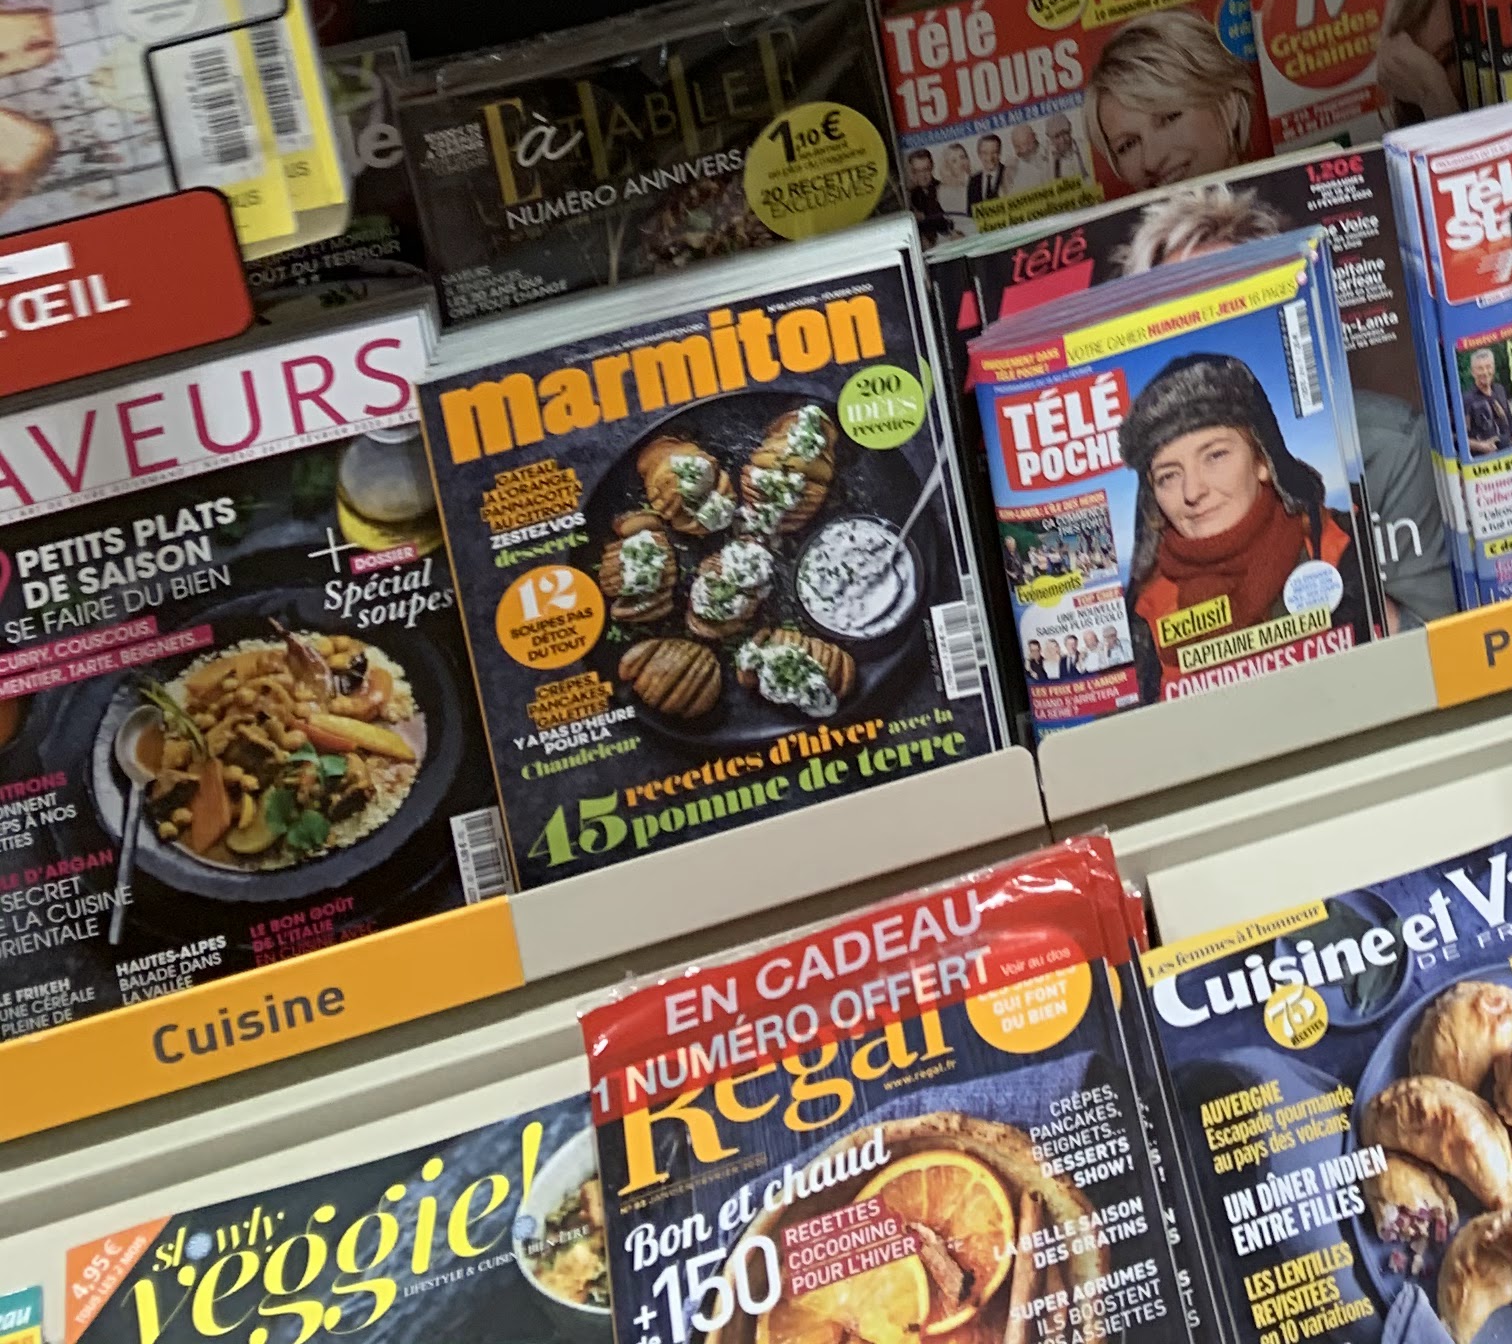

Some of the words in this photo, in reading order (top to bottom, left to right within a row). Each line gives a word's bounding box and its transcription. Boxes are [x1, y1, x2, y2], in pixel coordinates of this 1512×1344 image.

[1269, 8, 1382, 60] Grandes
[957, 38, 1085, 116] JOURS
[506, 184, 618, 230] NUMÉRO
[788, 161, 878, 198] RECETTES
[440, 295, 888, 465] marmiton
[855, 373, 903, 398] 200
[1002, 371, 1124, 451] TÉLÉ
[16, 527, 124, 580] PETITS
[132, 496, 238, 546] PLATS
[79, 535, 214, 595] SAISON
[494, 530, 591, 570] desserts
[323, 564, 433, 616] Spécial
[357, 584, 459, 631] soupes
[1160, 598, 1231, 646] Exclusif
[1182, 631, 1257, 670] CAPITAINE
[1258, 608, 1331, 650] MARLEAU
[623, 739, 766, 809] recettes
[769, 717, 886, 770] d'hiver
[526, 790, 635, 870] 45
[633, 771, 791, 852] pomme
[856, 727, 967, 780] terre
[115, 935, 227, 978] HAUTES-ALPES
[665, 976, 739, 1036] EN
[755, 889, 984, 1001] CADEAU
[1152, 924, 1399, 1028] Cuisine
[1401, 892, 1460, 952] et
[152, 986, 348, 1066] Cuisine
[624, 1005, 820, 1103] NUMÉRO
[829, 945, 992, 1030] OFFERT
[624, 1211, 714, 1270] Bon
[718, 1192, 760, 1228] et
[760, 1130, 893, 1214] chaud
[1223, 1191, 1260, 1225] UN
[1261, 1160, 1318, 1213] DÎNER
[1318, 1144, 1389, 1189] INDIEN
[784, 1198, 883, 1246] RECETTES
[787, 1217, 899, 1270] COCOONING
[1232, 1211, 1304, 1258] ENTRE
[1306, 1187, 1366, 1231] FILLES
[651, 1232, 784, 1344] 150
[791, 1258, 842, 1294] POUR
[845, 1237, 918, 1280] L'HIVER
